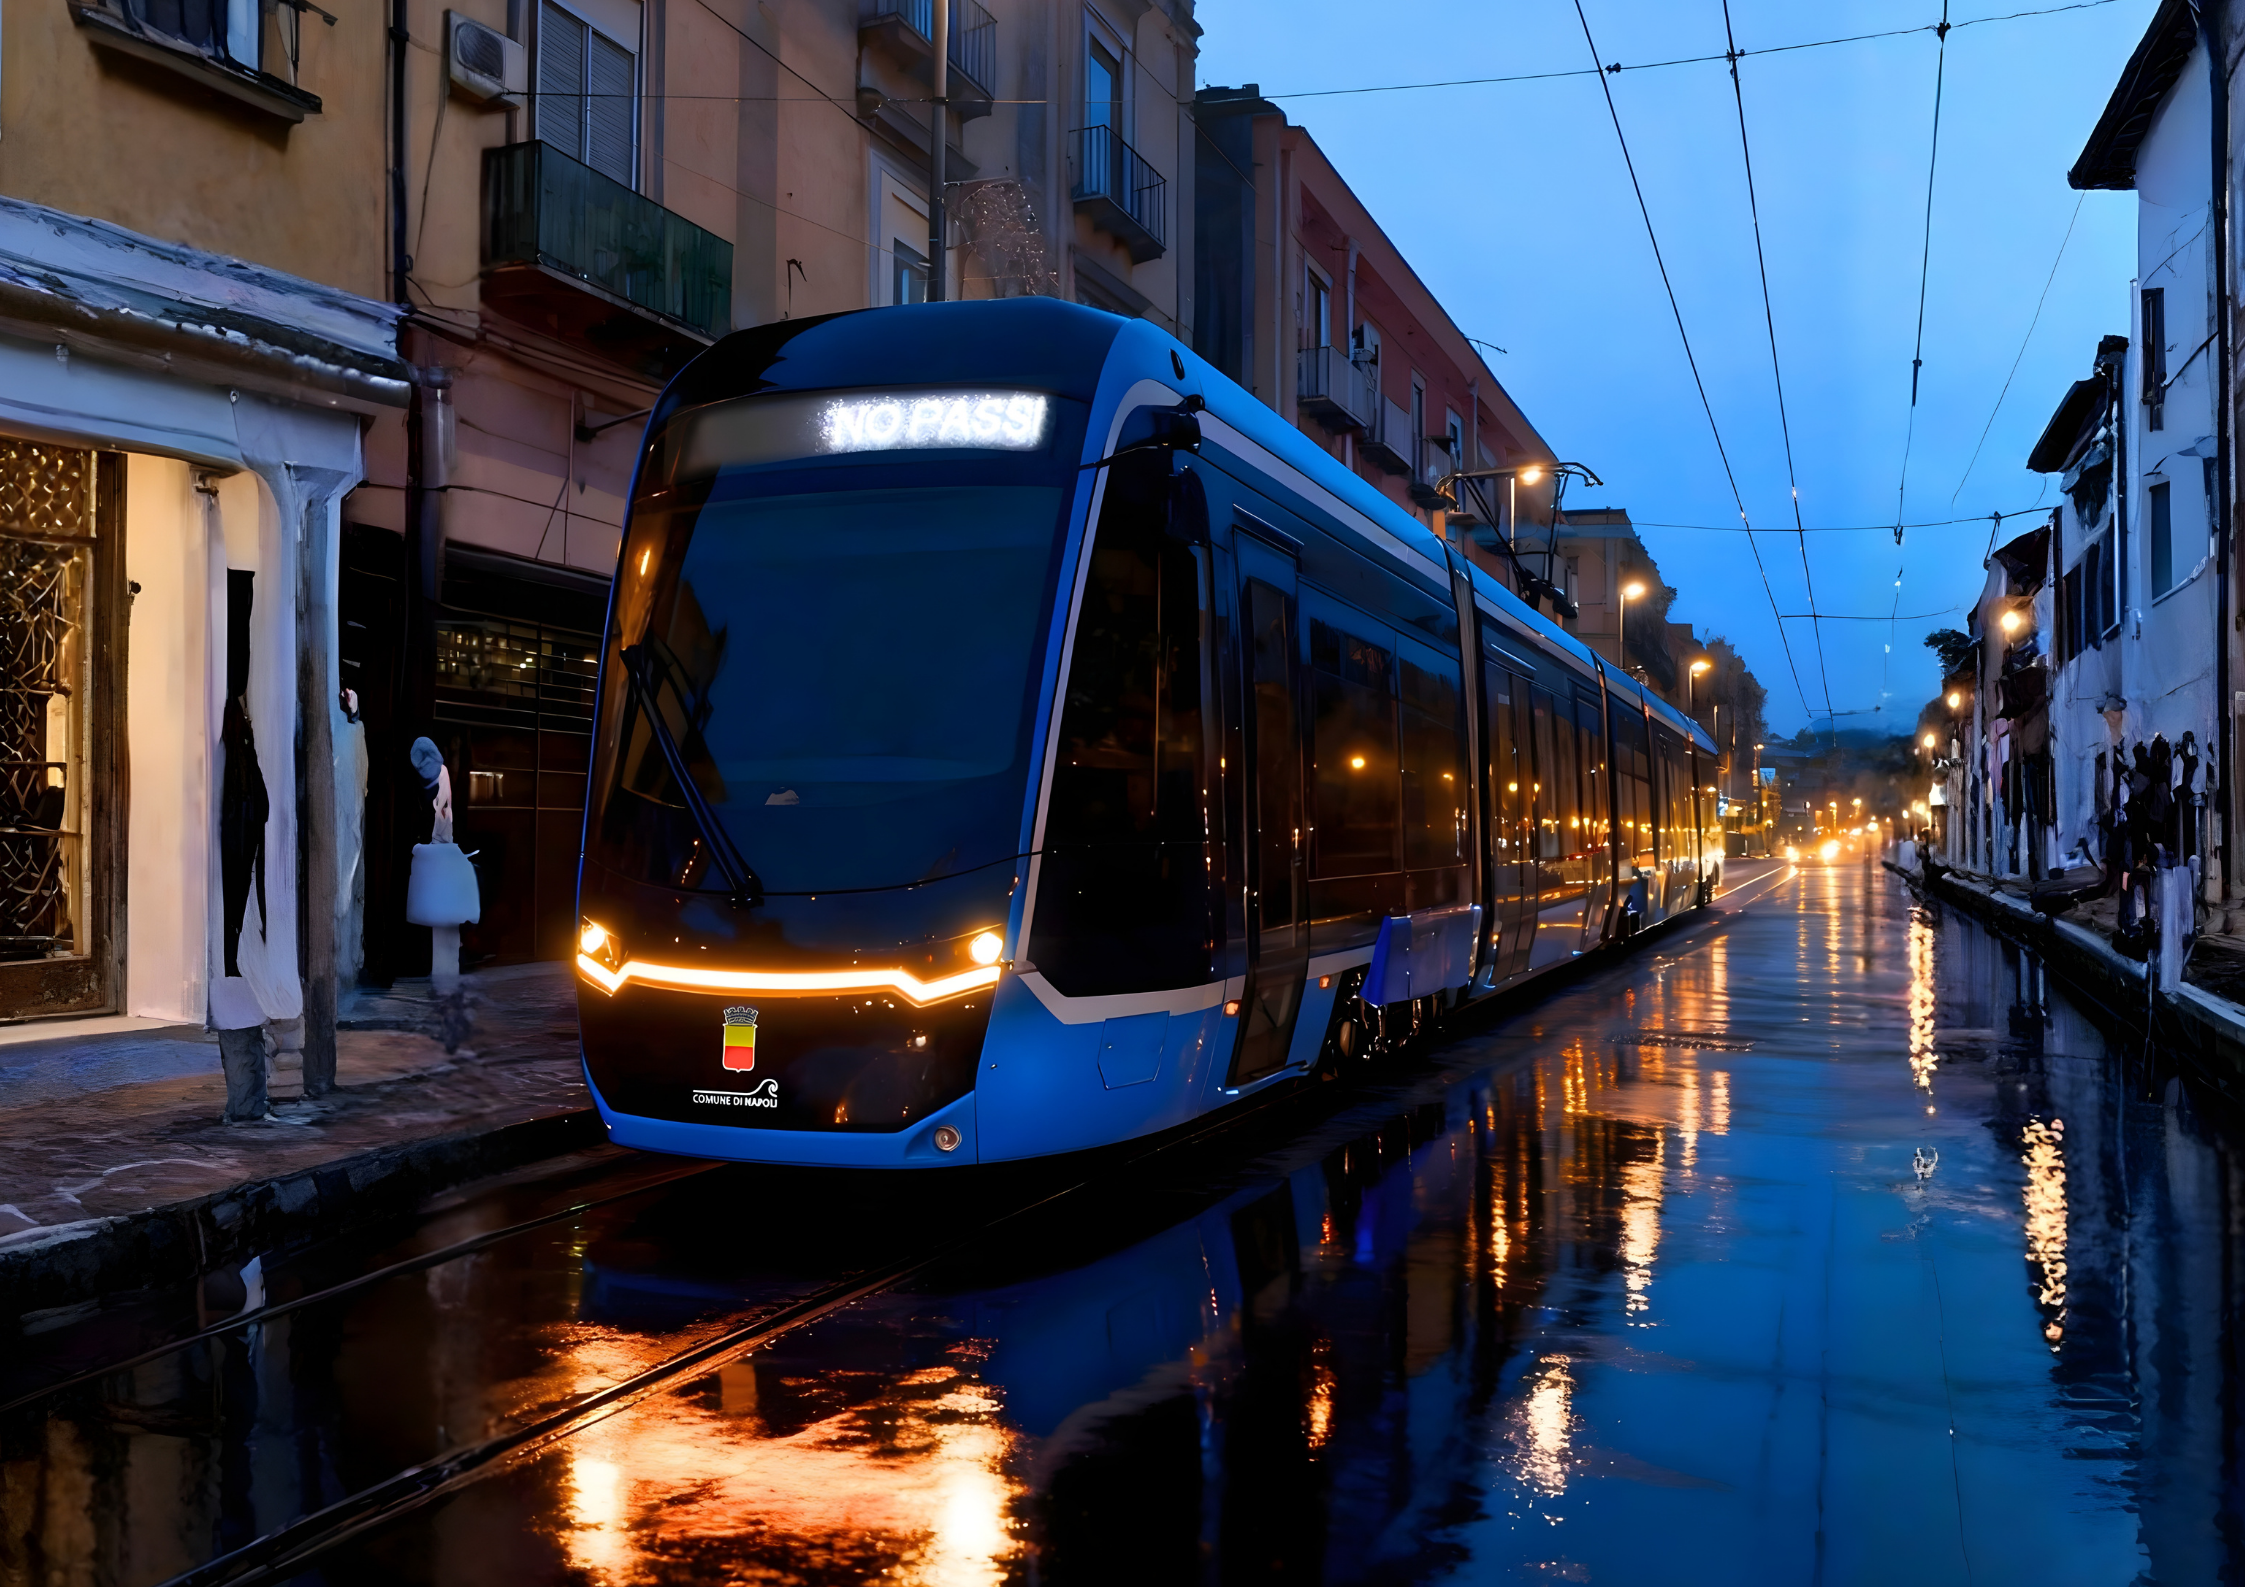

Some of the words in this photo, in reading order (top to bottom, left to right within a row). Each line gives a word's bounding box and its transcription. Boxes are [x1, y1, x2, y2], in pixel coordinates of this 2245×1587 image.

[830, 400, 903, 445] NO
[692, 1094, 731, 1105] COMUNE
[733, 1096, 743, 1106] DI
[744, 1097, 777, 1108] NAPOLI
